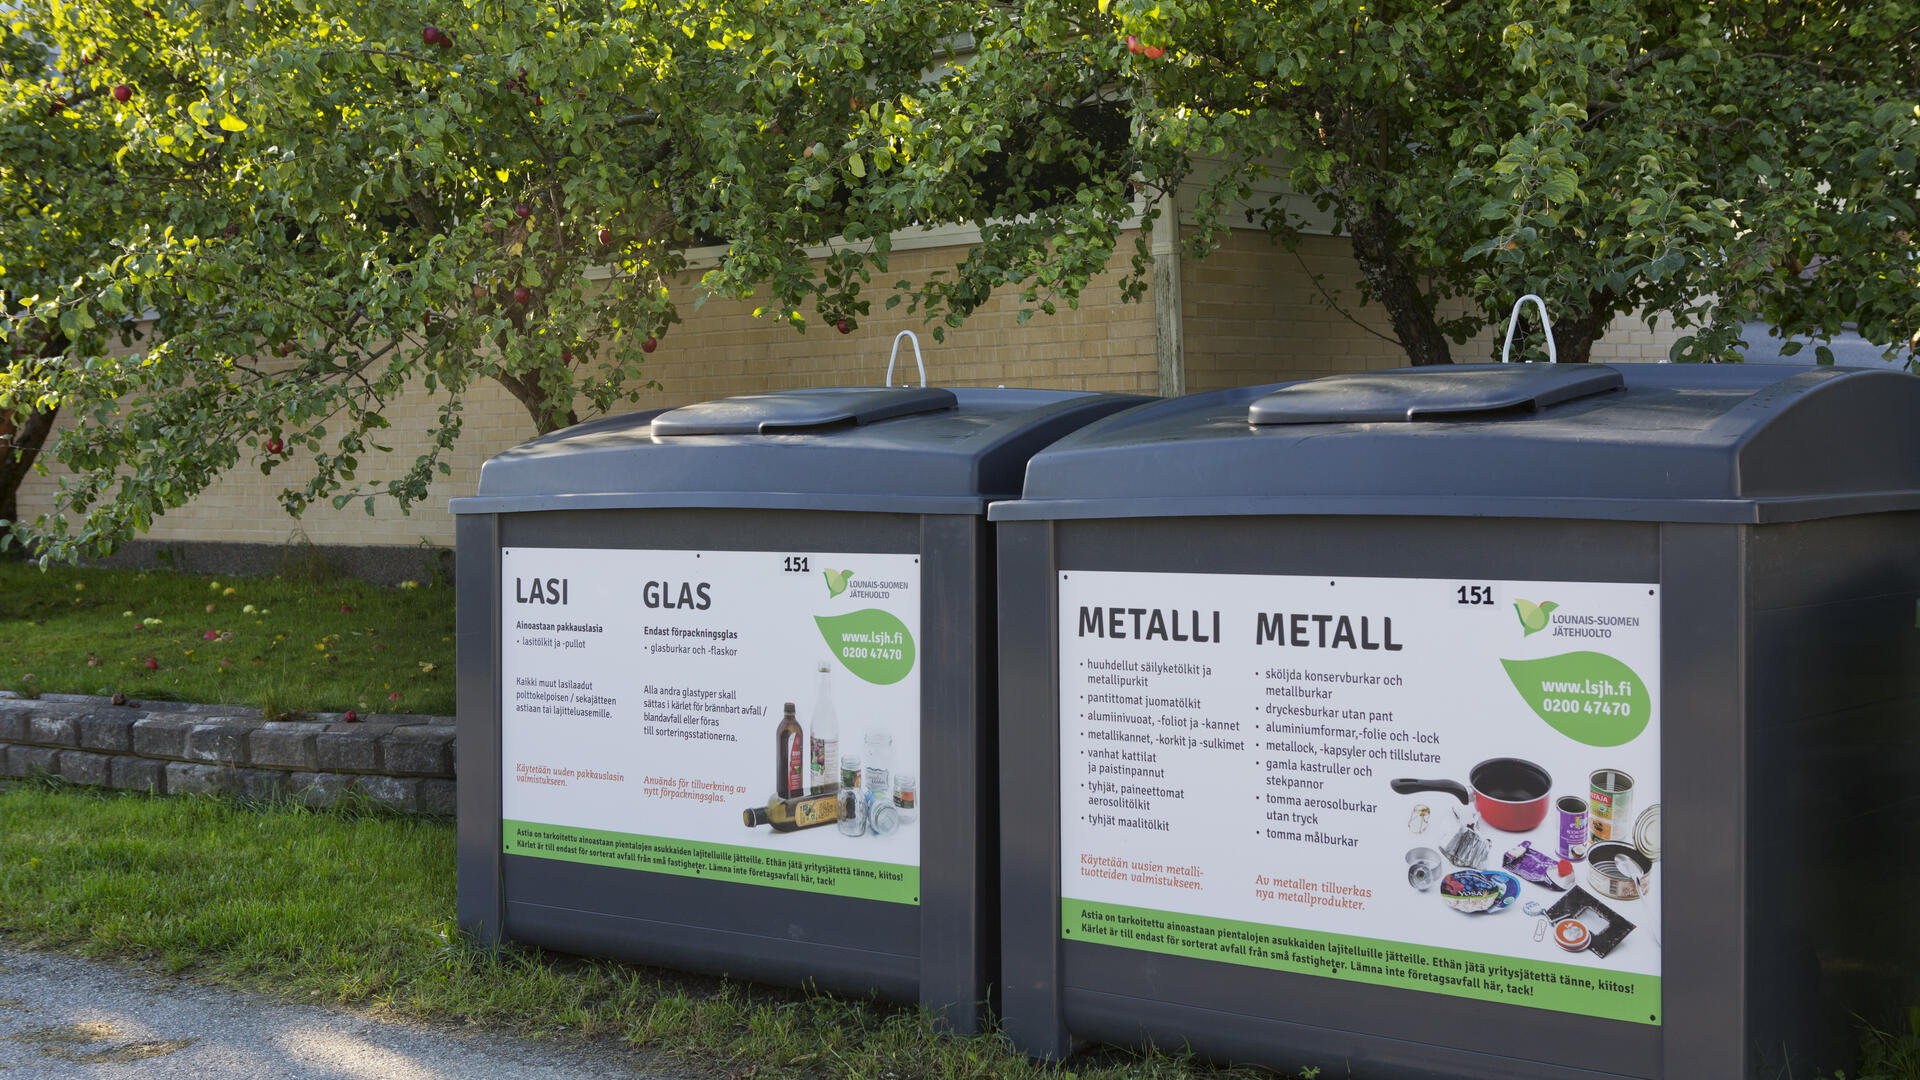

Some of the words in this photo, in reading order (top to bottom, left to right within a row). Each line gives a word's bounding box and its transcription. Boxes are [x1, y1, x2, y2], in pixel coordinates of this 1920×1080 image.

[783, 556, 810, 572] 151
[516, 577, 567, 605] LASI
[849, 579, 908, 590] LOUNAIS-SUOMEN
[642, 580, 711, 610] GLAS
[849, 588, 889, 599] JÄTEHUOLTO
[1457, 585, 1494, 605] 151
[515, 620, 555, 630] Ainoastaan
[556, 622, 603, 633] pakkauslasia
[1078, 605, 1220, 643] METALLI
[1552, 614, 1639, 626] LOUNAIS-SUOMEN
[643, 625, 669, 636] Endast
[670, 626, 738, 641] förpackningsglas
[841, 631, 903, 646] www.lsjh.fi
[1255, 612, 1403, 651] METALL
[1551, 625, 1612, 638] JÄTEHUOLTO
[522, 635, 552, 647] lasitölkit
[553, 637, 561, 649] ja
[562, 639, 586, 650] -pullot
[650, 642, 691, 654] glasburkar
[691, 645, 705, 654] och
[707, 645, 738, 656] -flaskor
[842, 646, 868, 659] 0200
[869, 647, 902, 660] 47470
[1087, 658, 1138, 671] huuhdellut
[1140, 661, 1200, 675] säilyketölkit
[1202, 664, 1211, 678] ja
[1265, 667, 1302, 682] sköljda
[1304, 669, 1381, 685] konservburkar
[1383, 674, 1402, 686] och
[516, 677, 537, 686] Kaikki
[538, 679, 557, 688] muut
[557, 679, 592, 690] lasilaadut
[1087, 673, 1148, 688] metallipurkit
[1541, 679, 1631, 698] www.lsjh.fi
[516, 689, 569, 702] polttokelpoisen
[575, 693, 616, 706] sekajätteen
[643, 684, 658, 694] Alla
[659, 686, 680, 696] andra
[681, 687, 717, 700] glastyper
[718, 689, 736, 700] skall
[1087, 692, 1143, 705] pantittomat
[1145, 695, 1200, 709] juomatölkit
[1265, 685, 1332, 699] metallburkar
[515, 703, 541, 713] astiaan
[542, 705, 552, 714] tai
[643, 698, 665, 709] sättas
[671, 699, 691, 711] kärlet
[692, 700, 703, 711] för
[704, 702, 740, 714] brännbart
[741, 704, 762, 715] avfall
[1265, 702, 1339, 718] dryckesburkar
[1341, 708, 1366, 720] utan
[1368, 711, 1393, 723] pant
[1543, 697, 1580, 713] 0200
[1583, 700, 1631, 716] 47470
[643, 711, 682, 723] blandavfall
[683, 714, 699, 725] eller
[700, 715, 719, 727] föras
[1087, 709, 1154, 726] alumiinivuoat,
[1157, 714, 1187, 727] -foliot
[1189, 717, 1198, 730] ja
[1201, 717, 1240, 731] -kannet
[643, 725, 654, 735] till
[1389, 729, 1409, 742] och
[1411, 730, 1440, 744] -lock
[1087, 729, 1153, 745] metallikannet,
[1155, 733, 1186, 746] -korkit
[1187, 735, 1197, 749] ja
[1199, 737, 1244, 751] -sulkimet
[1087, 747, 1119, 759] vanhat
[1121, 749, 1156, 763] kattilat
[1266, 740, 1317, 756] metallock,
[1319, 743, 1366, 759] -kapsyler
[1368, 747, 1387, 759] och
[1389, 748, 1441, 763] tillslutare
[1087, 761, 1096, 774] ja
[1099, 763, 1164, 778] paistinpannut
[1265, 758, 1297, 771] gamla
[1300, 759, 1351, 775] kastruller
[1353, 765, 1372, 776] och
[1087, 780, 1118, 794] tyhjät,
[1120, 783, 1184, 799] paineettomat
[1265, 774, 1324, 789] stekpannor
[1088, 796, 1150, 810] aerosolitölkit
[1266, 792, 1301, 806] tomma
[1304, 798, 1377, 813] aerosolburkar
[1088, 812, 1115, 827] tyhjät
[1117, 817, 1169, 831] maalitölkit
[1266, 810, 1289, 821] utan
[1291, 812, 1318, 826] tryck
[1266, 827, 1301, 841] tomma
[1304, 831, 1359, 847] målburkar
[516, 828, 533, 837] Astia
[542, 831, 577, 842] tarkoitettu
[578, 835, 614, 847] ainoastaan
[614, 839, 652, 852] pientalojen
[653, 844, 691, 856] asukkaiden
[692, 848, 732, 861] lajitelluille
[732, 853, 764, 865] jätteille.
[765, 857, 786, 867] Ethän
[787, 859, 802, 870] jätä
[803, 862, 851, 875] yritysjätettä
[852, 867, 876, 880] tänne,
[878, 869, 903, 881] kiitos!
[1080, 853, 1128, 869] Käytetään
[1131, 860, 1163, 873] uusien
[1166, 865, 1204, 877] metalli-
[1080, 866, 1127, 881] tuotteiden
[1130, 871, 1203, 890] valmistukseen.
[1255, 874, 1269, 886] Av
[1272, 878, 1317, 891] metallen
[1321, 881, 1371, 898] tillverkas
[1255, 889, 1274, 901] nya
[1277, 891, 1365, 910] metallprodukter.
[1080, 909, 1103, 920] Astia
[1104, 914, 1115, 922] on
[1117, 914, 1164, 929] tarkoitettu
[1166, 920, 1215, 936] ainoastaan
[1217, 928, 1269, 944] pientalojen
[1271, 936, 1325, 951] asukkaiden
[1327, 941, 1383, 959] lajitelluille
[1385, 949, 1429, 966] jätteille.
[1432, 956, 1462, 970] Ethän
[1464, 960, 1485, 973] jätä
[1487, 965, 1556, 983] yritysjätettä
[1559, 974, 1595, 991] tänne,
[1598, 978, 1634, 994] kiitos!
[1081, 922, 1107, 935] Kärlet
[1109, 926, 1118, 936] är
[1120, 928, 1133, 939] till
[1135, 931, 1164, 943] endast
[1165, 934, 1179, 945] för
[1181, 938, 1217, 951] sorterat
[1219, 943, 1246, 955] avfall
[1248, 945, 1268, 958] från
[1270, 950, 1289, 961] små
[1291, 952, 1347, 969] fastigheter.
[1350, 960, 1383, 974] Lämna
[1384, 965, 1405, 978] inte
[1407, 968, 1480, 988] företagsavfall
[1483, 978, 1503, 994] här,
[1506, 983, 1533, 996] tack!
